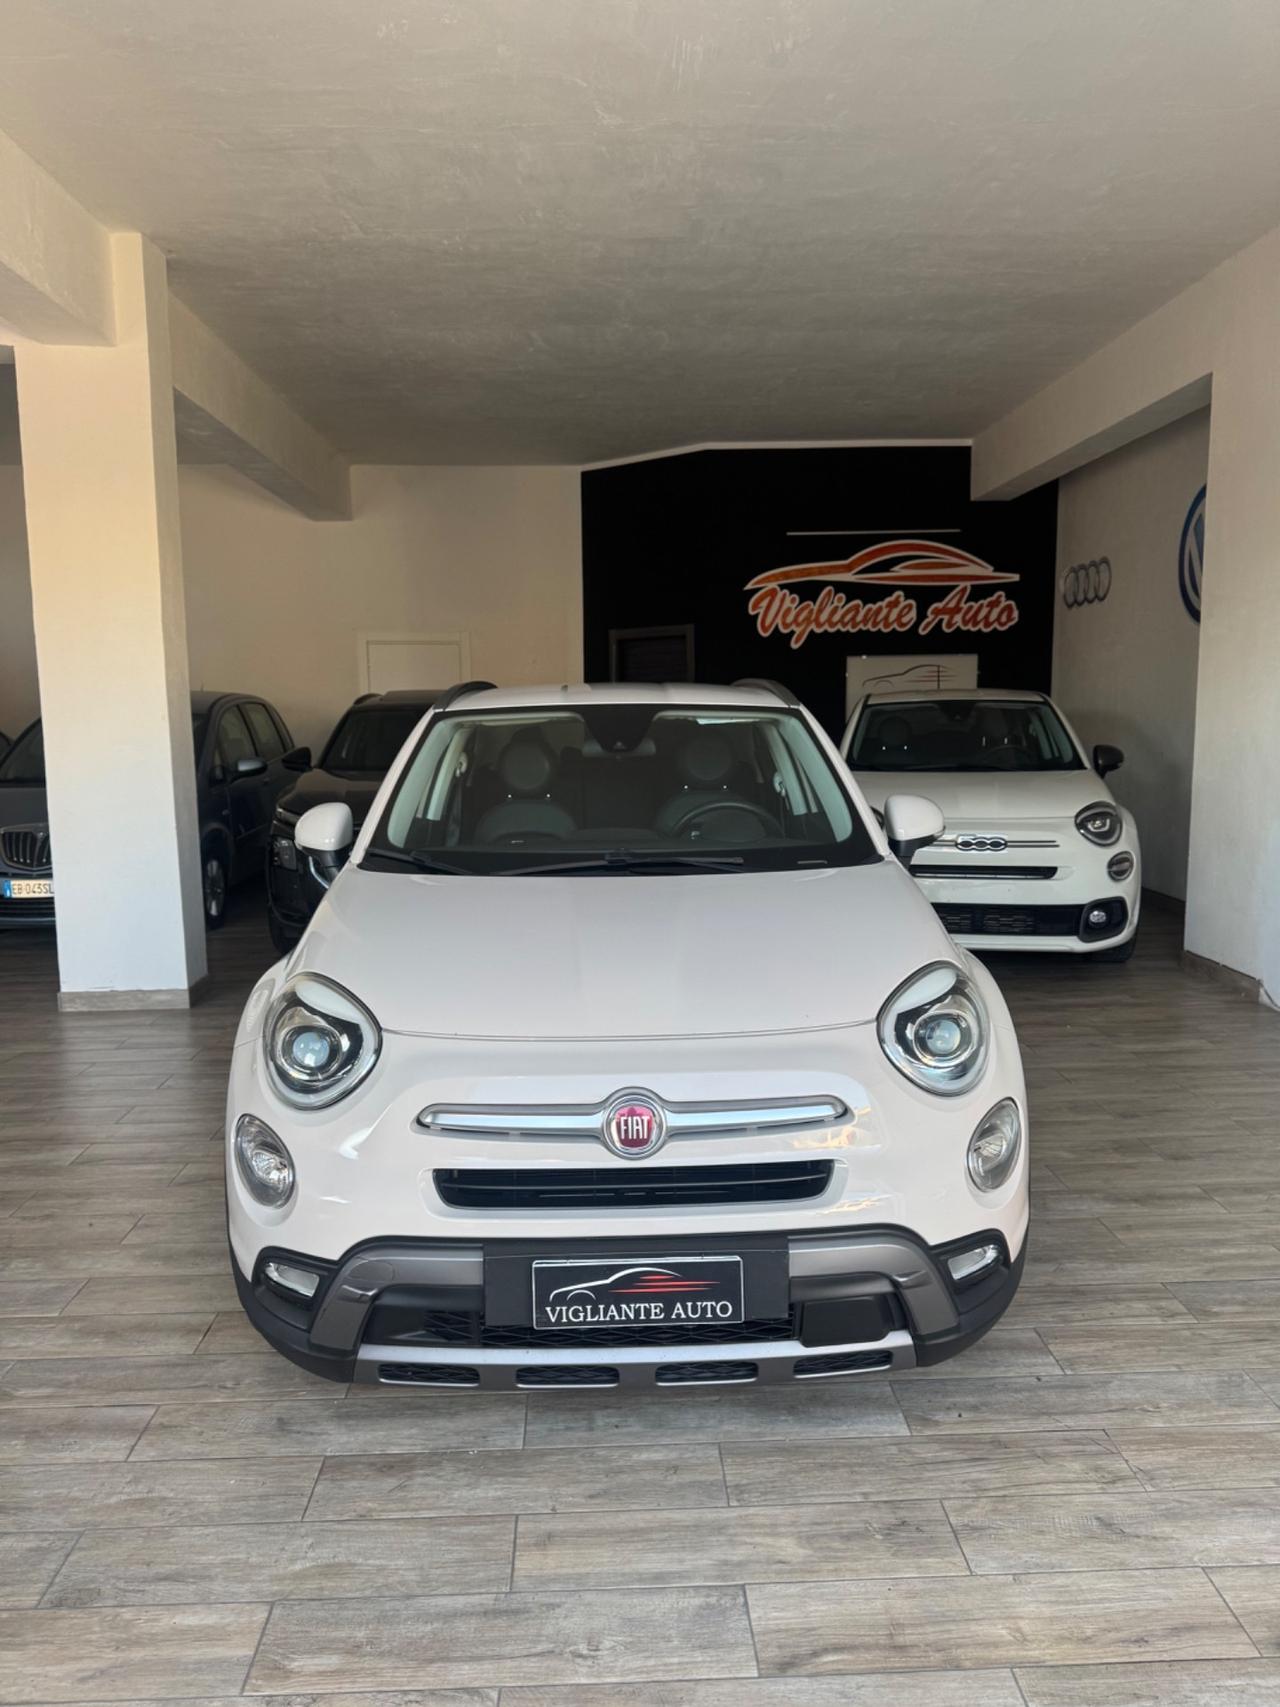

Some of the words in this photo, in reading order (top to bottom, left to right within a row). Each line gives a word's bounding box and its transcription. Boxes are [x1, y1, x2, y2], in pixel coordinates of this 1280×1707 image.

[748, 583, 917, 649] Vigliante
[918, 583, 1019, 635] Auto
[620, 1115, 651, 1140] FIAT
[545, 1303, 665, 1323] VIGLIANTE
[671, 1301, 733, 1319] AUTO
